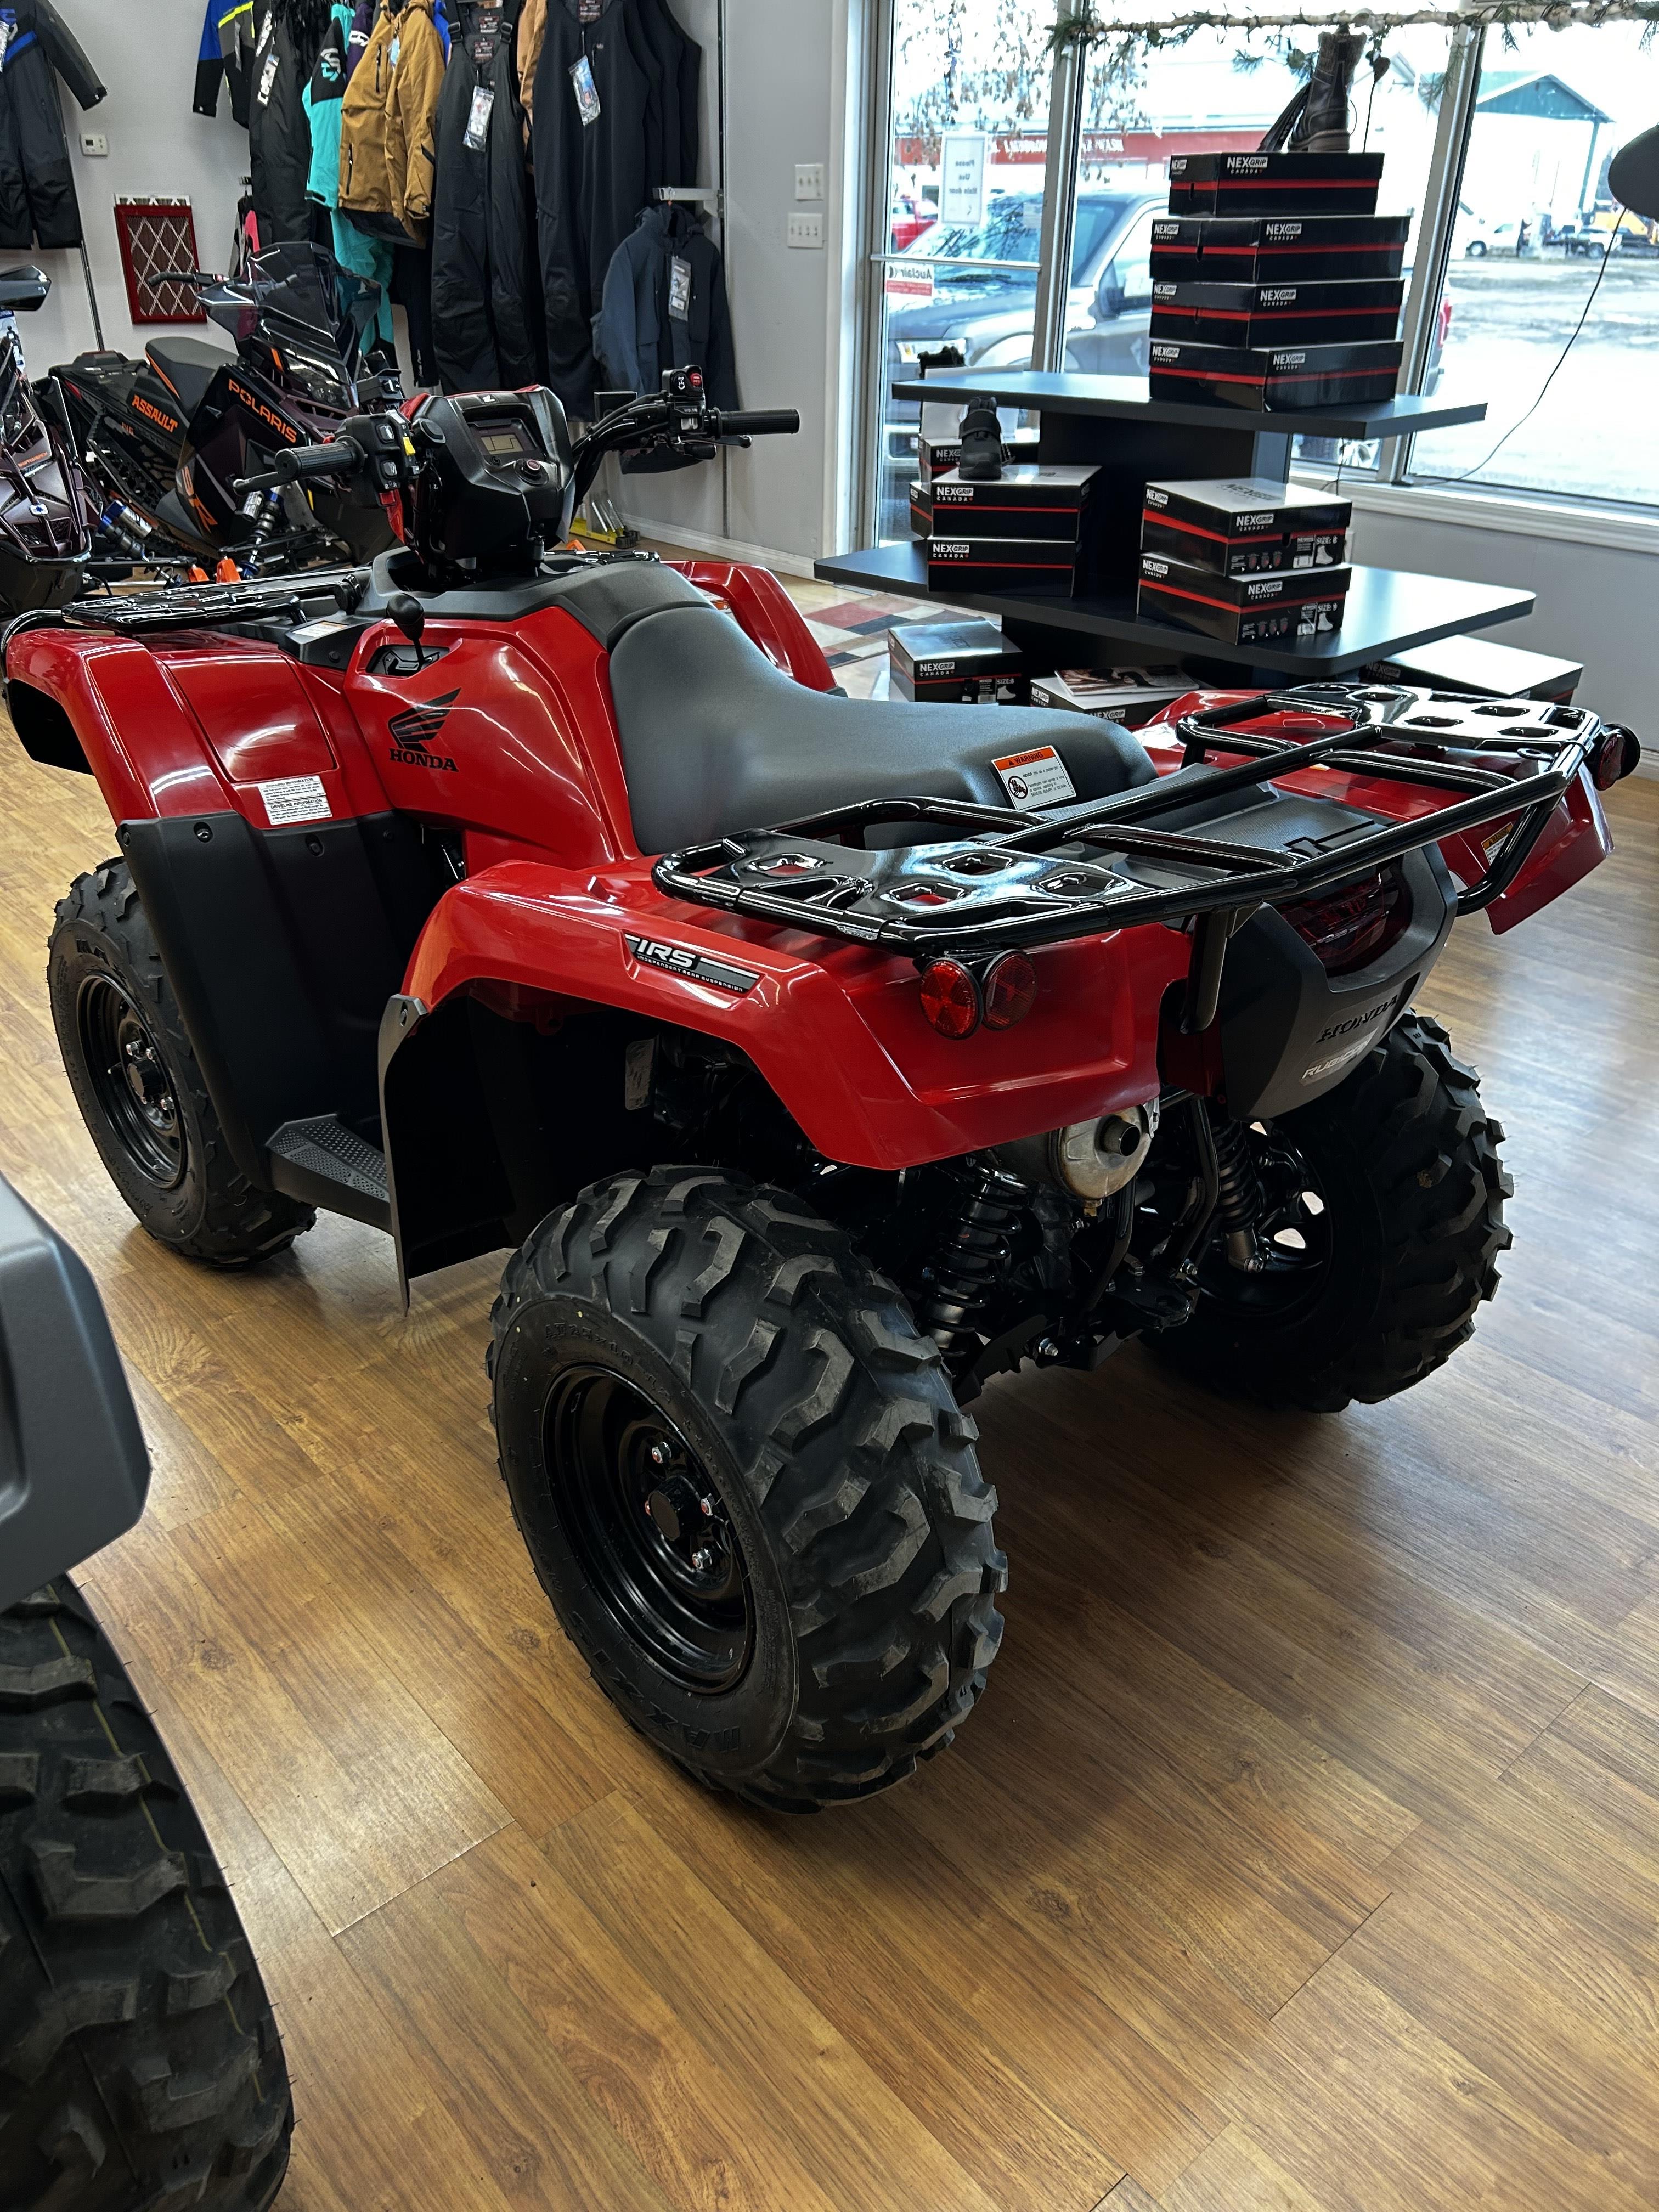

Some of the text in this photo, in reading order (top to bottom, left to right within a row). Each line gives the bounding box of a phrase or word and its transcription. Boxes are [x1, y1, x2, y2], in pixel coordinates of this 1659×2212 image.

[1227, 156, 1268, 169] NEXGRIP
[1266, 223, 1302, 236] NEXGRIP
[1260, 289, 1297, 302] NEXGRIP
[131, 394, 178, 433] ASSAULT
[228, 378, 297, 444] POLARIS
[936, 449, 961, 458] NEXG
[936, 487, 974, 496] NEXGRIP
[932, 544, 970, 554] NEXGRIP
[919, 661, 955, 673] NEXGRIP
[389, 747, 459, 772] HONDA
[1014, 752, 1043, 764] WARNING
[637, 939, 696, 968] IRS
[1315, 994, 1398, 1044] HONDA
